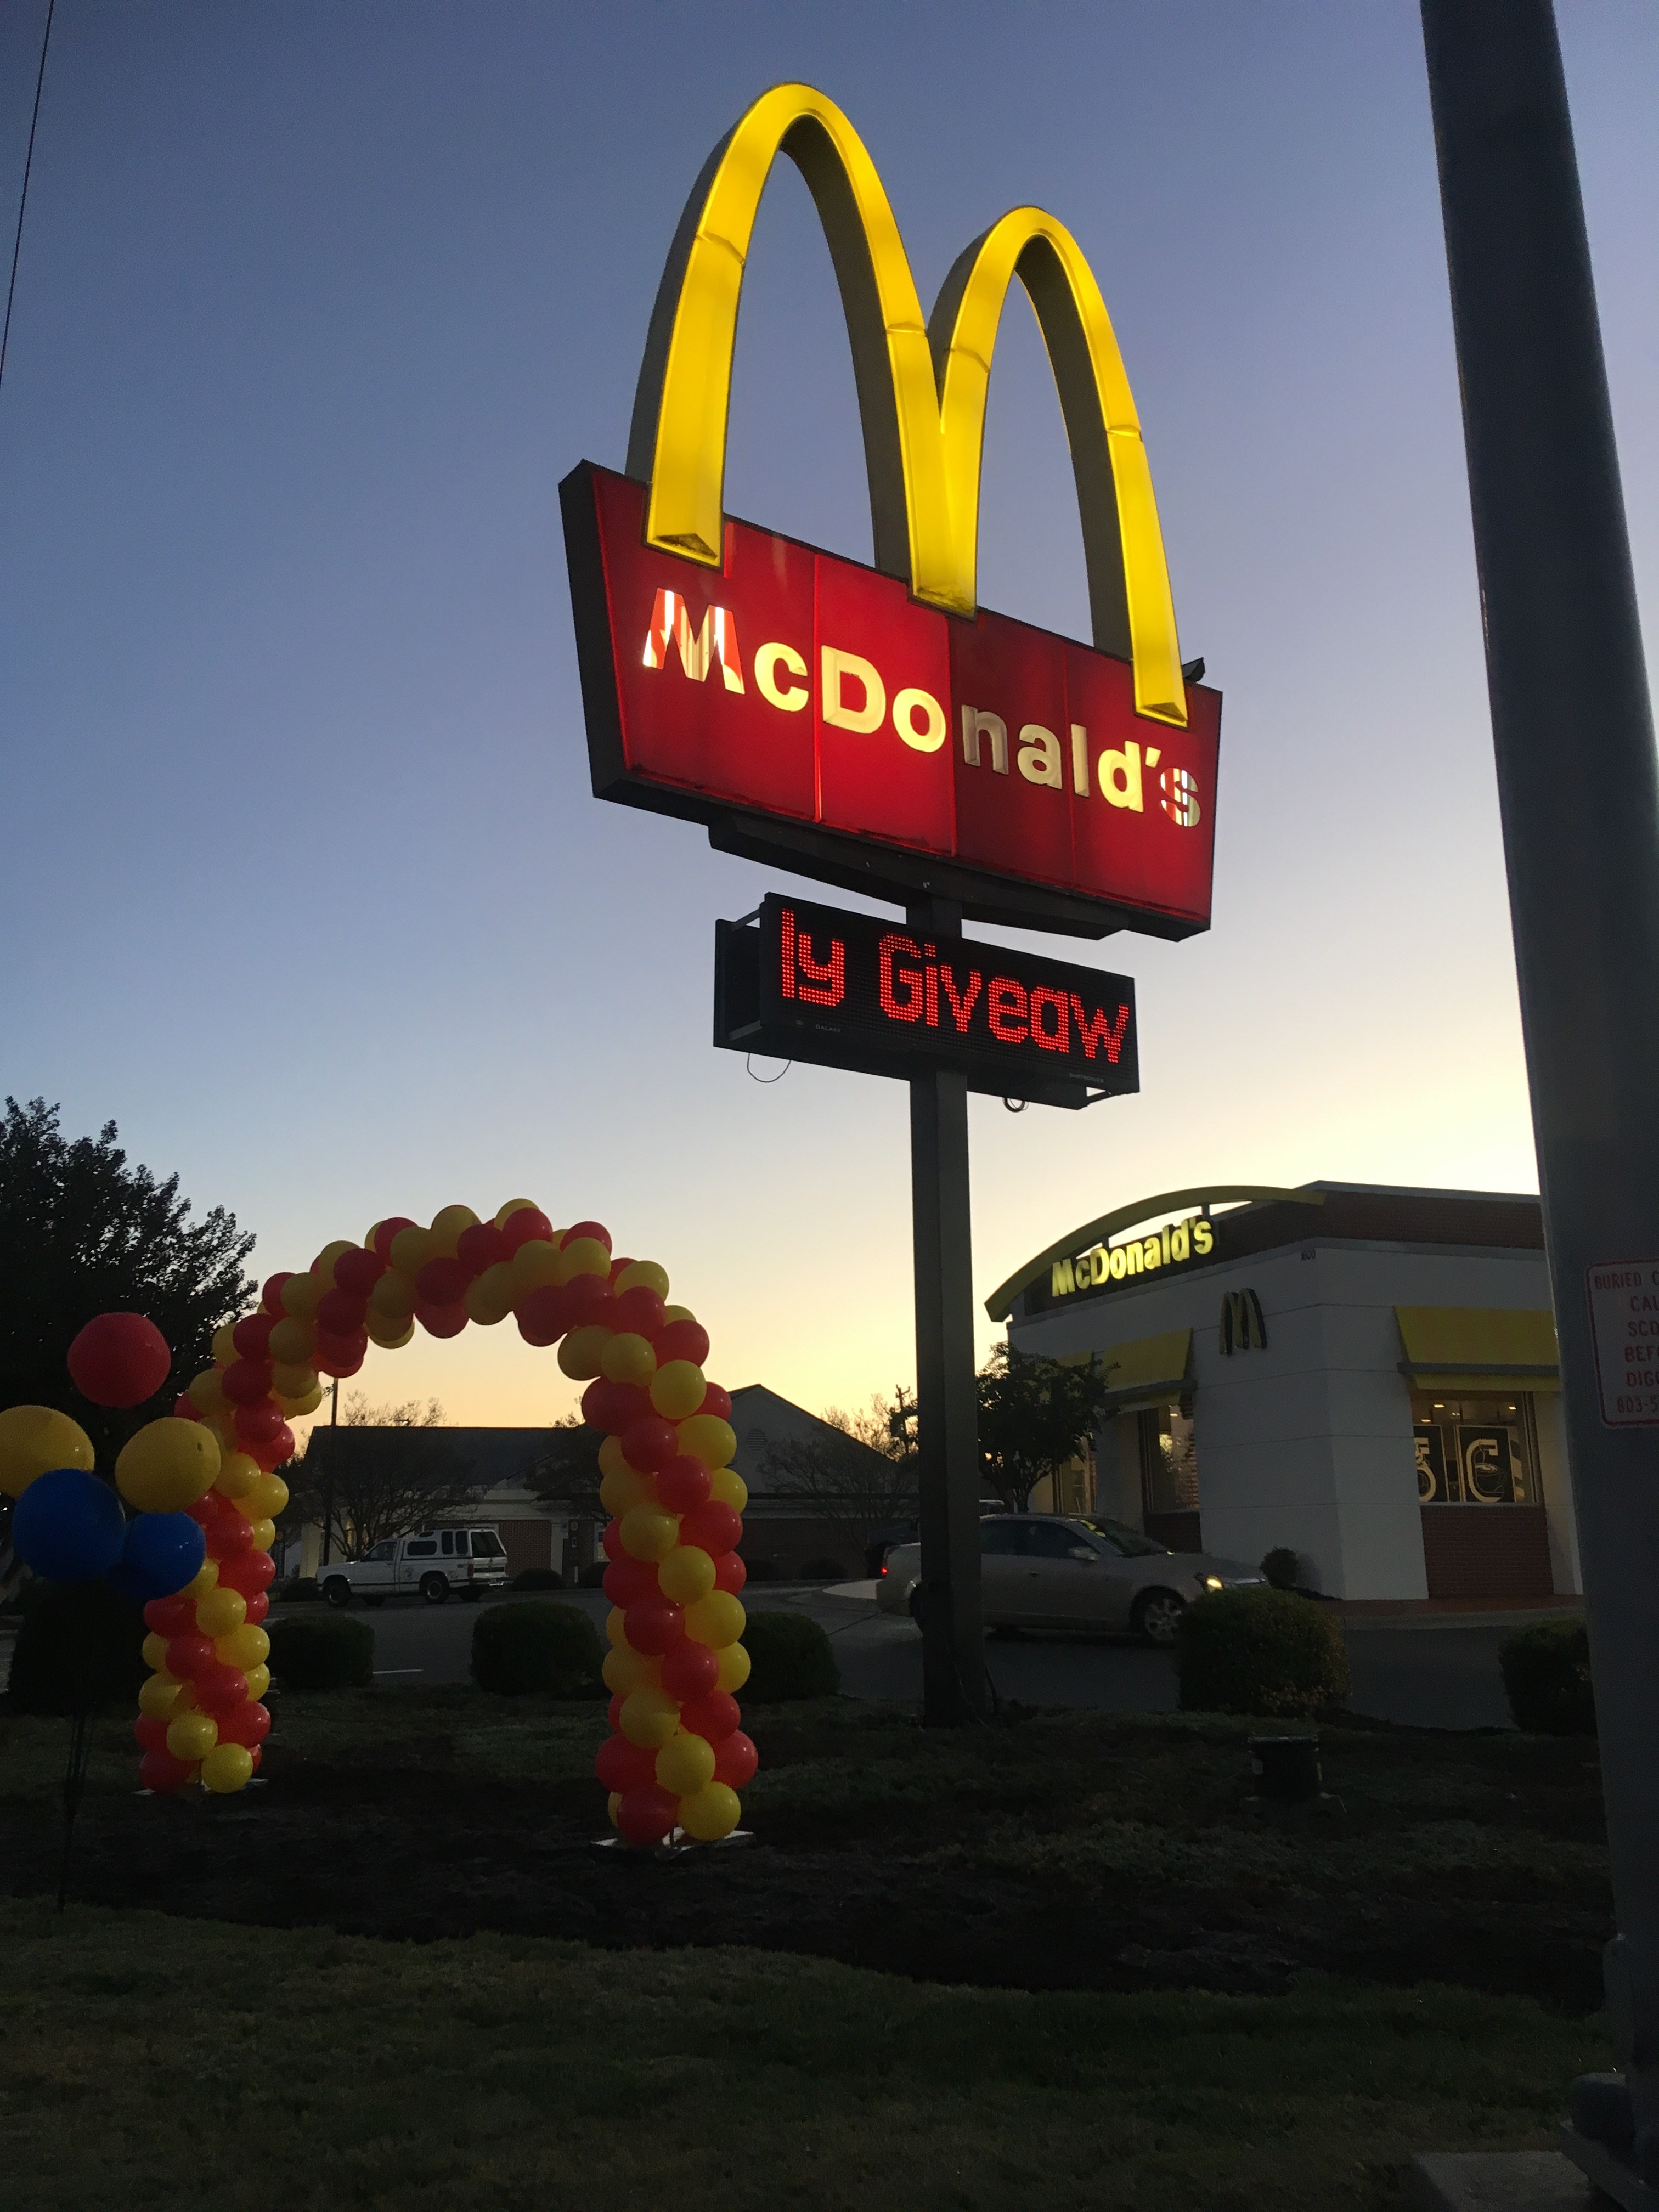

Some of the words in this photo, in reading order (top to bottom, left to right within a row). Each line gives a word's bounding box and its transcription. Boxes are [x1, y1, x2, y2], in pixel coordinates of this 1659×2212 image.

[642, 588, 1201, 827] McDonald's
[879, 932, 1130, 1064] Giveaw
[815, 1023, 842, 1034] GALAXY
[1052, 1214, 1214, 1297] McDonald's
[1594, 1271, 1642, 1290] BURIED
[1624, 1345, 1659, 1363] BEF
